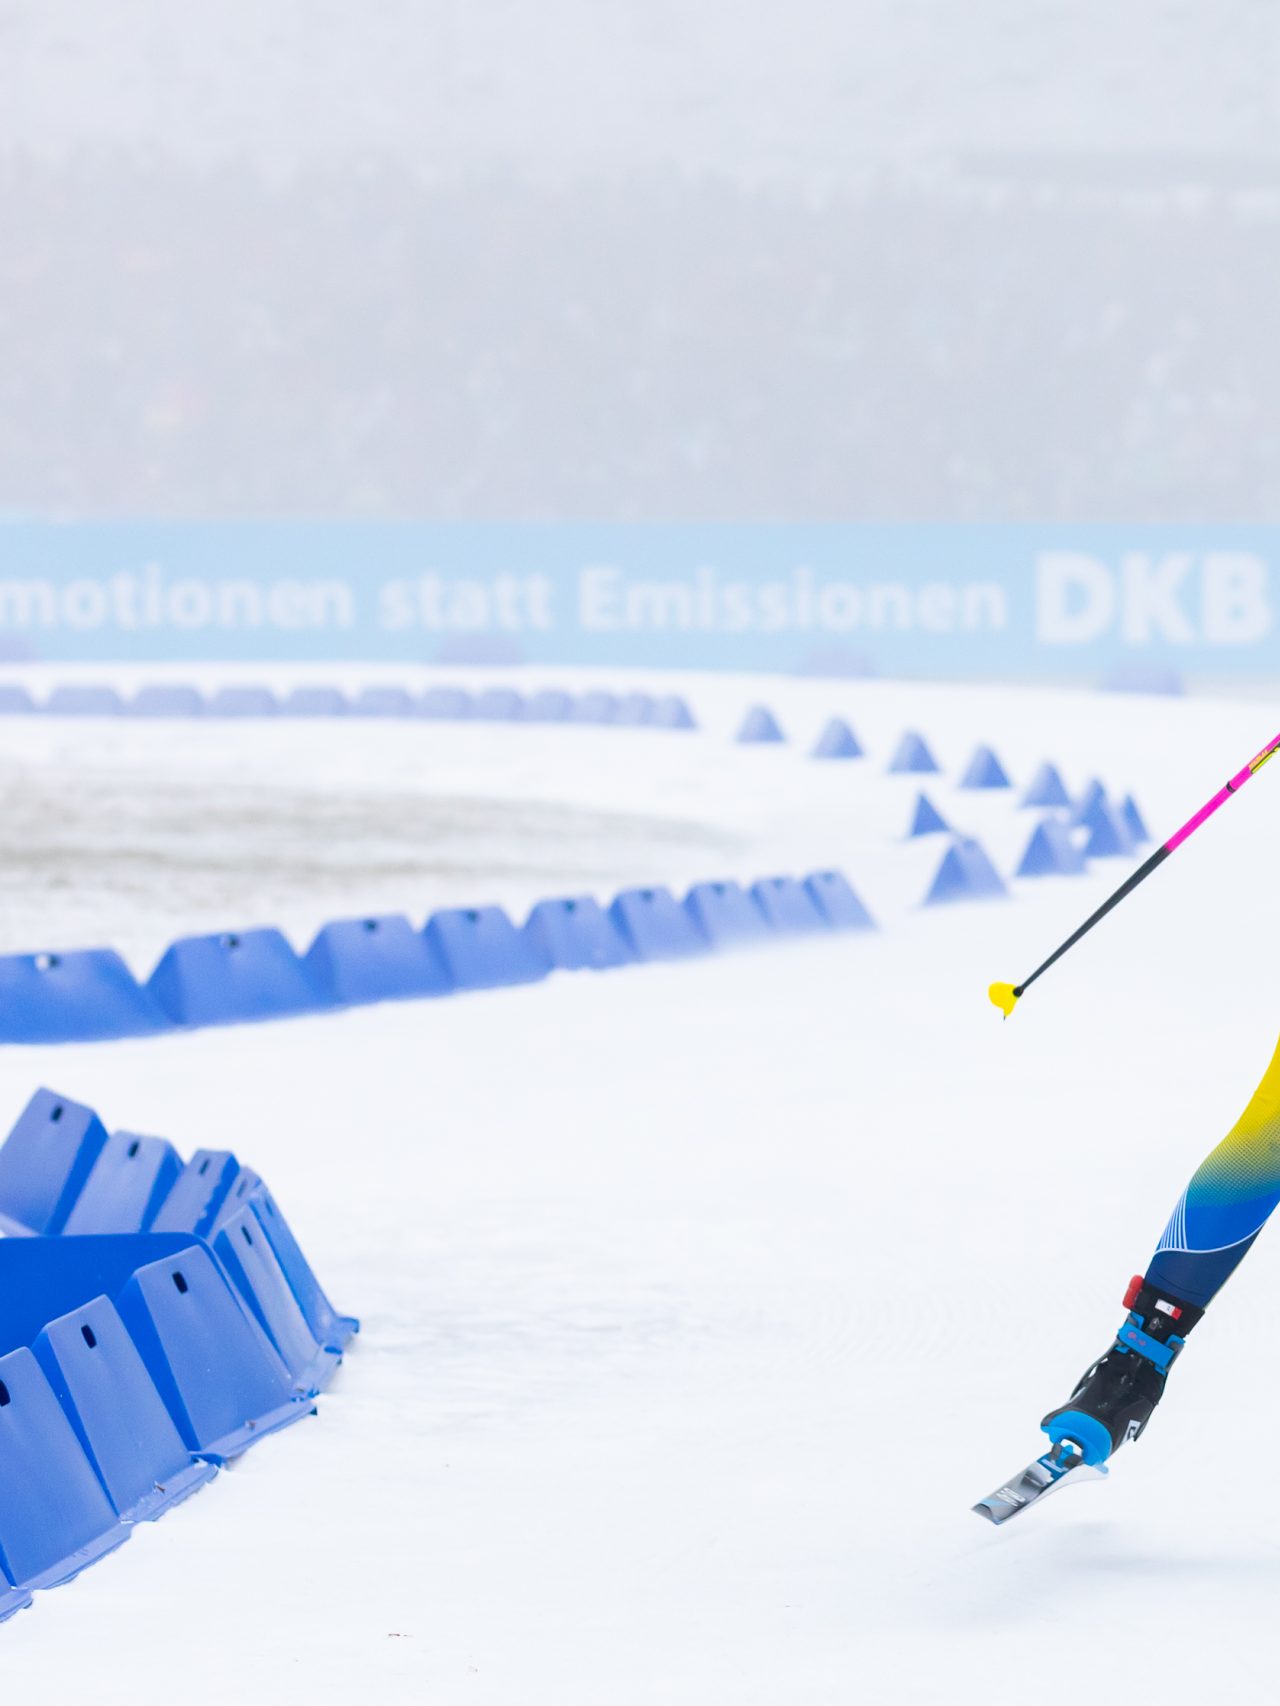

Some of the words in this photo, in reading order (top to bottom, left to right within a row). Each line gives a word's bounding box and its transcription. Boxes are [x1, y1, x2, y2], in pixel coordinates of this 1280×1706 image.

[378, 570, 556, 632] statt
[578, 561, 1006, 633] Emissionen
[1033, 551, 1273, 645] DKB
